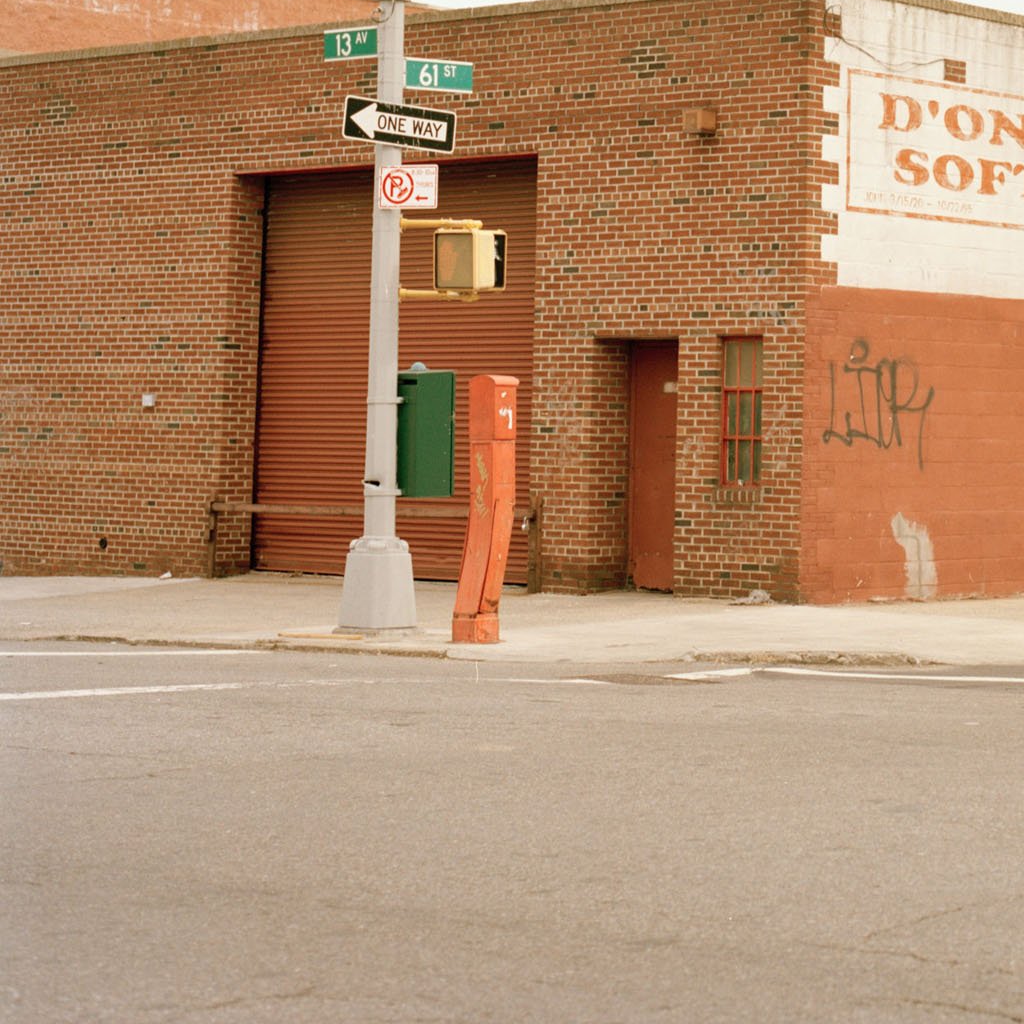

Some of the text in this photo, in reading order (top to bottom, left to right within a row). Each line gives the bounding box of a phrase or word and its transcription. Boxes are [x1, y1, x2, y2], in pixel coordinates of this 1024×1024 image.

[335, 31, 368, 57] 13 AV
[419, 63, 457, 87] 61 ST
[377, 114, 443, 138] ONE WAY
